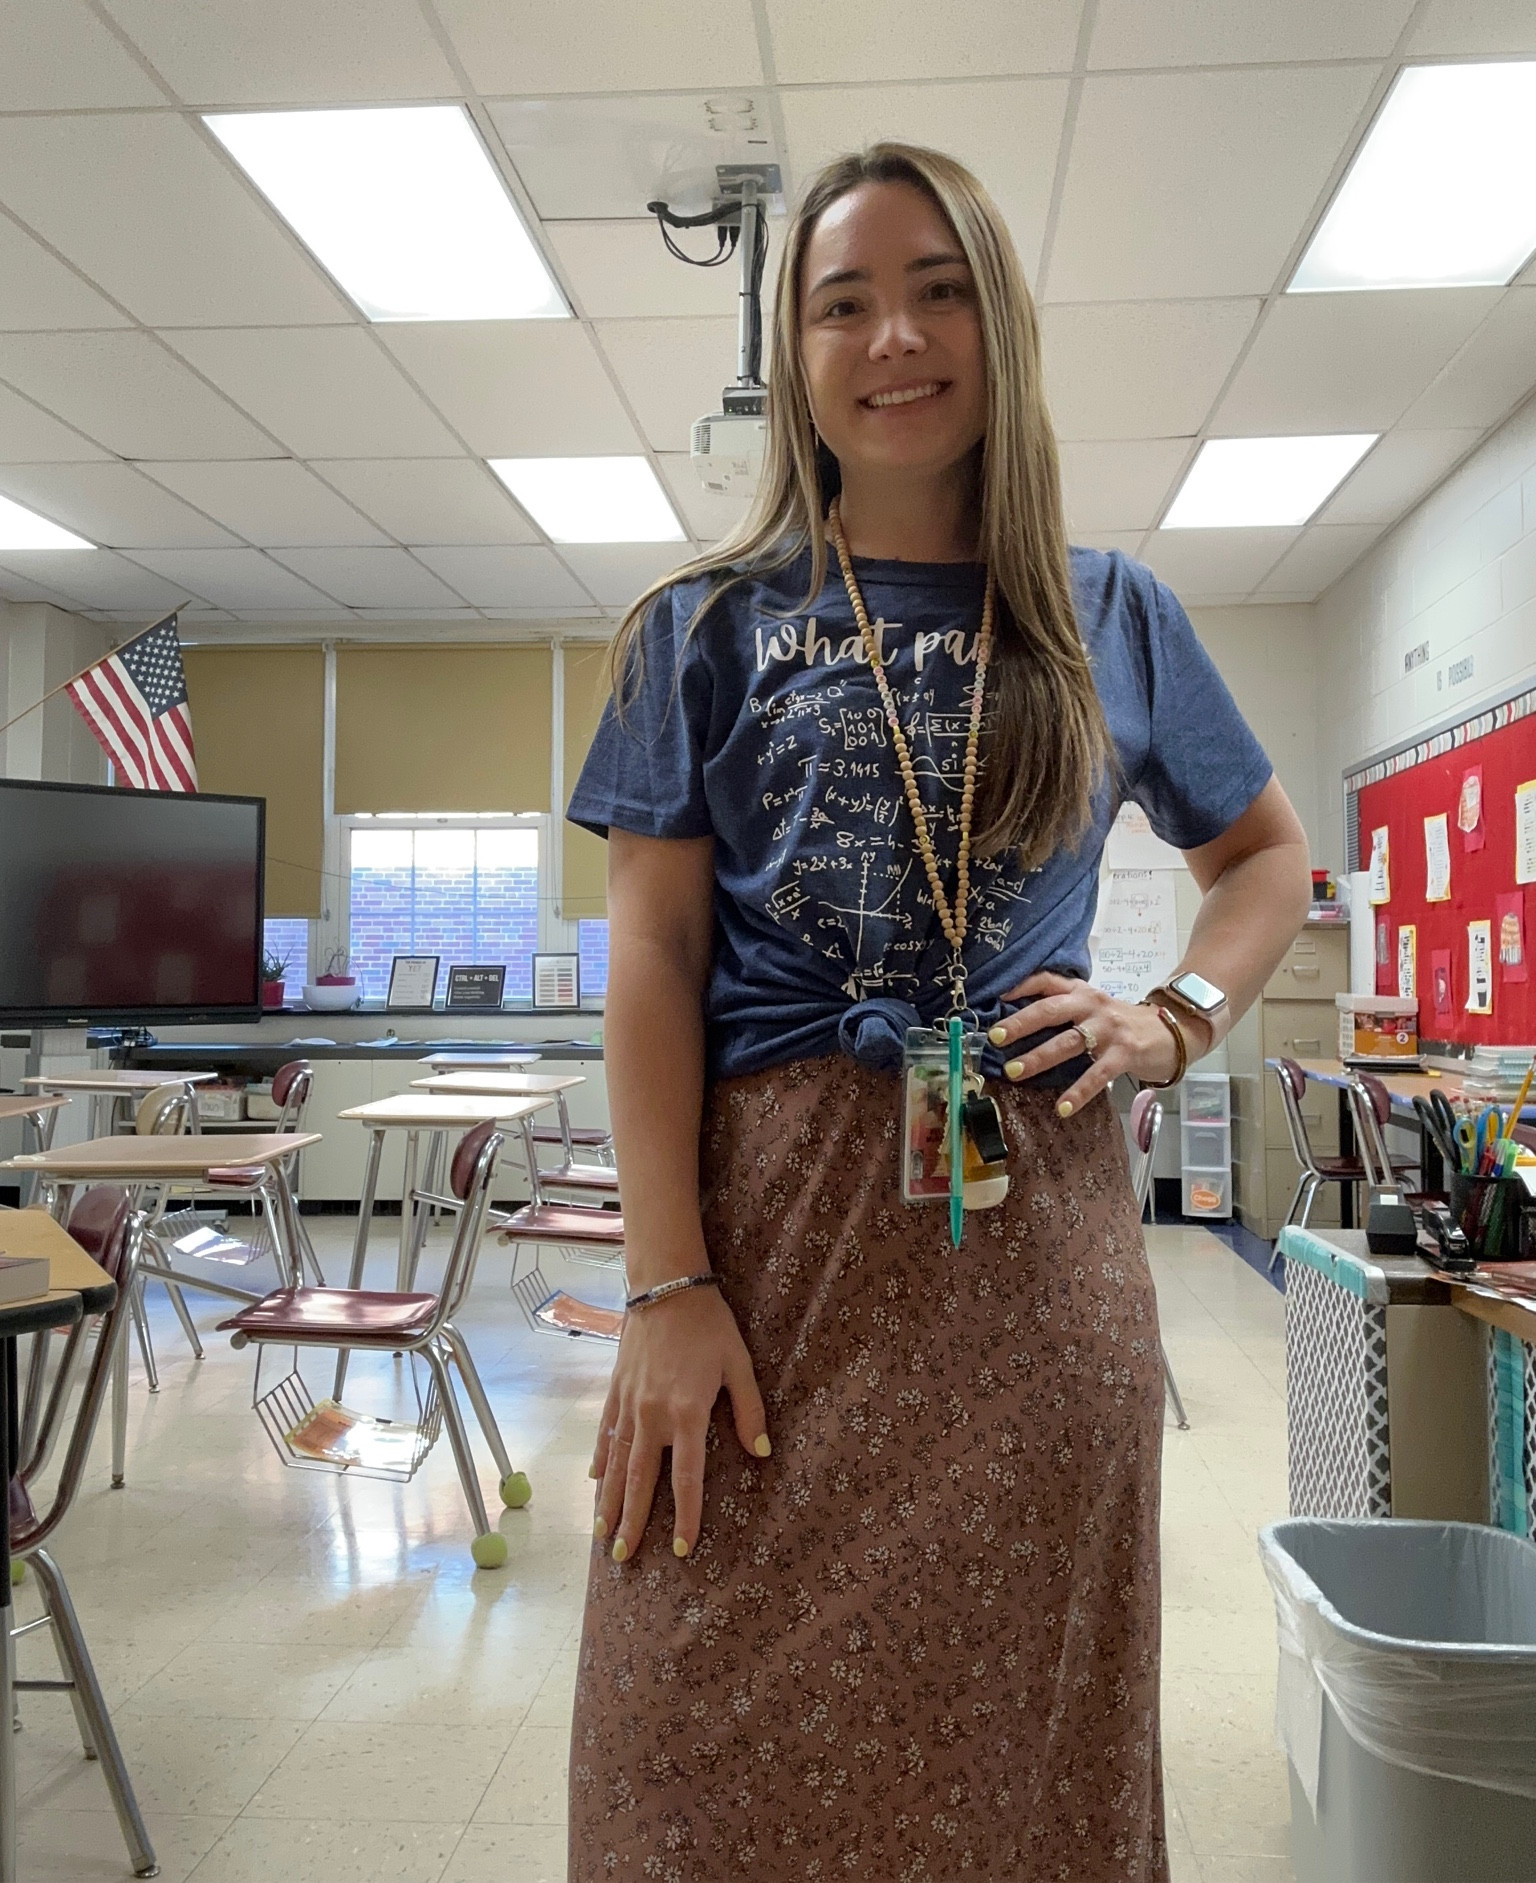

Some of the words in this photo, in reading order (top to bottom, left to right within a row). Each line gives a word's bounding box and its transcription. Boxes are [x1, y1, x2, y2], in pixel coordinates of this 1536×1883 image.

[756, 617, 903, 672] What
[455, 974, 468, 982] CTRL
[473, 974, 484, 982] ALT
[1398, 1033, 1407, 1043] 2
